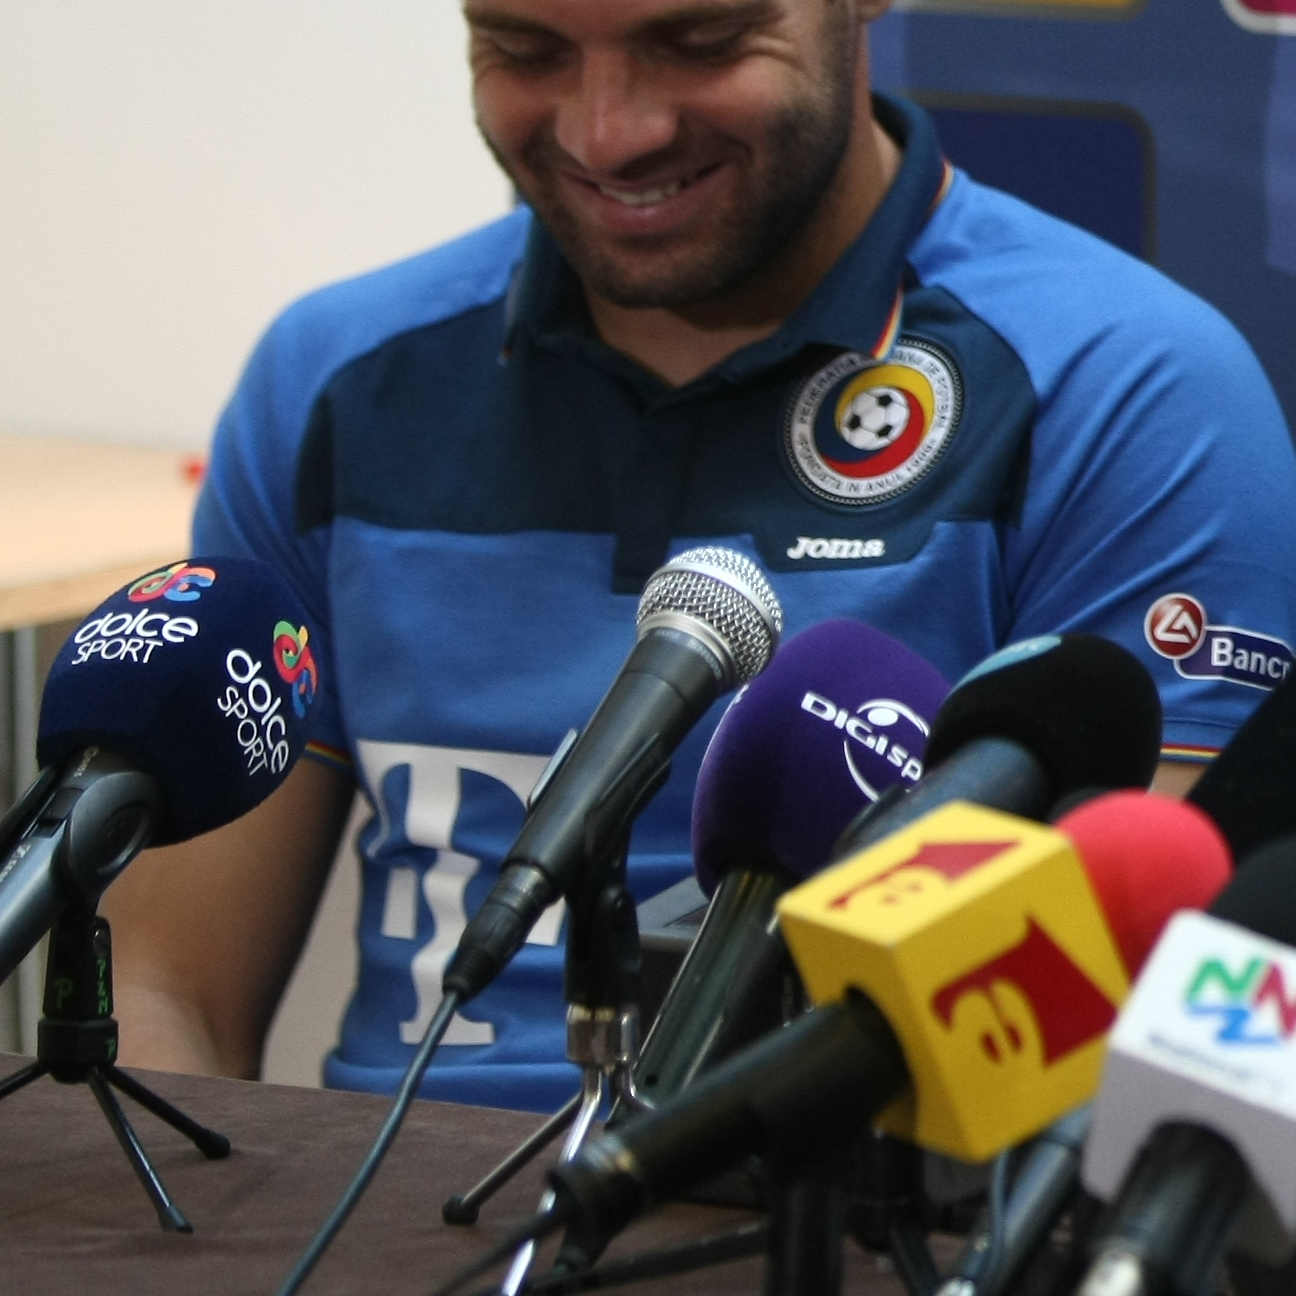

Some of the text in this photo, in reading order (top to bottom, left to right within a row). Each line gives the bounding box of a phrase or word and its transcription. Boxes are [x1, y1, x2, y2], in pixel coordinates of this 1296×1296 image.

[71, 638, 163, 665] SPORT
[74, 608, 199, 644] dolce
[217, 686, 268, 776] SPORT
[226, 649, 289, 774] dolce
